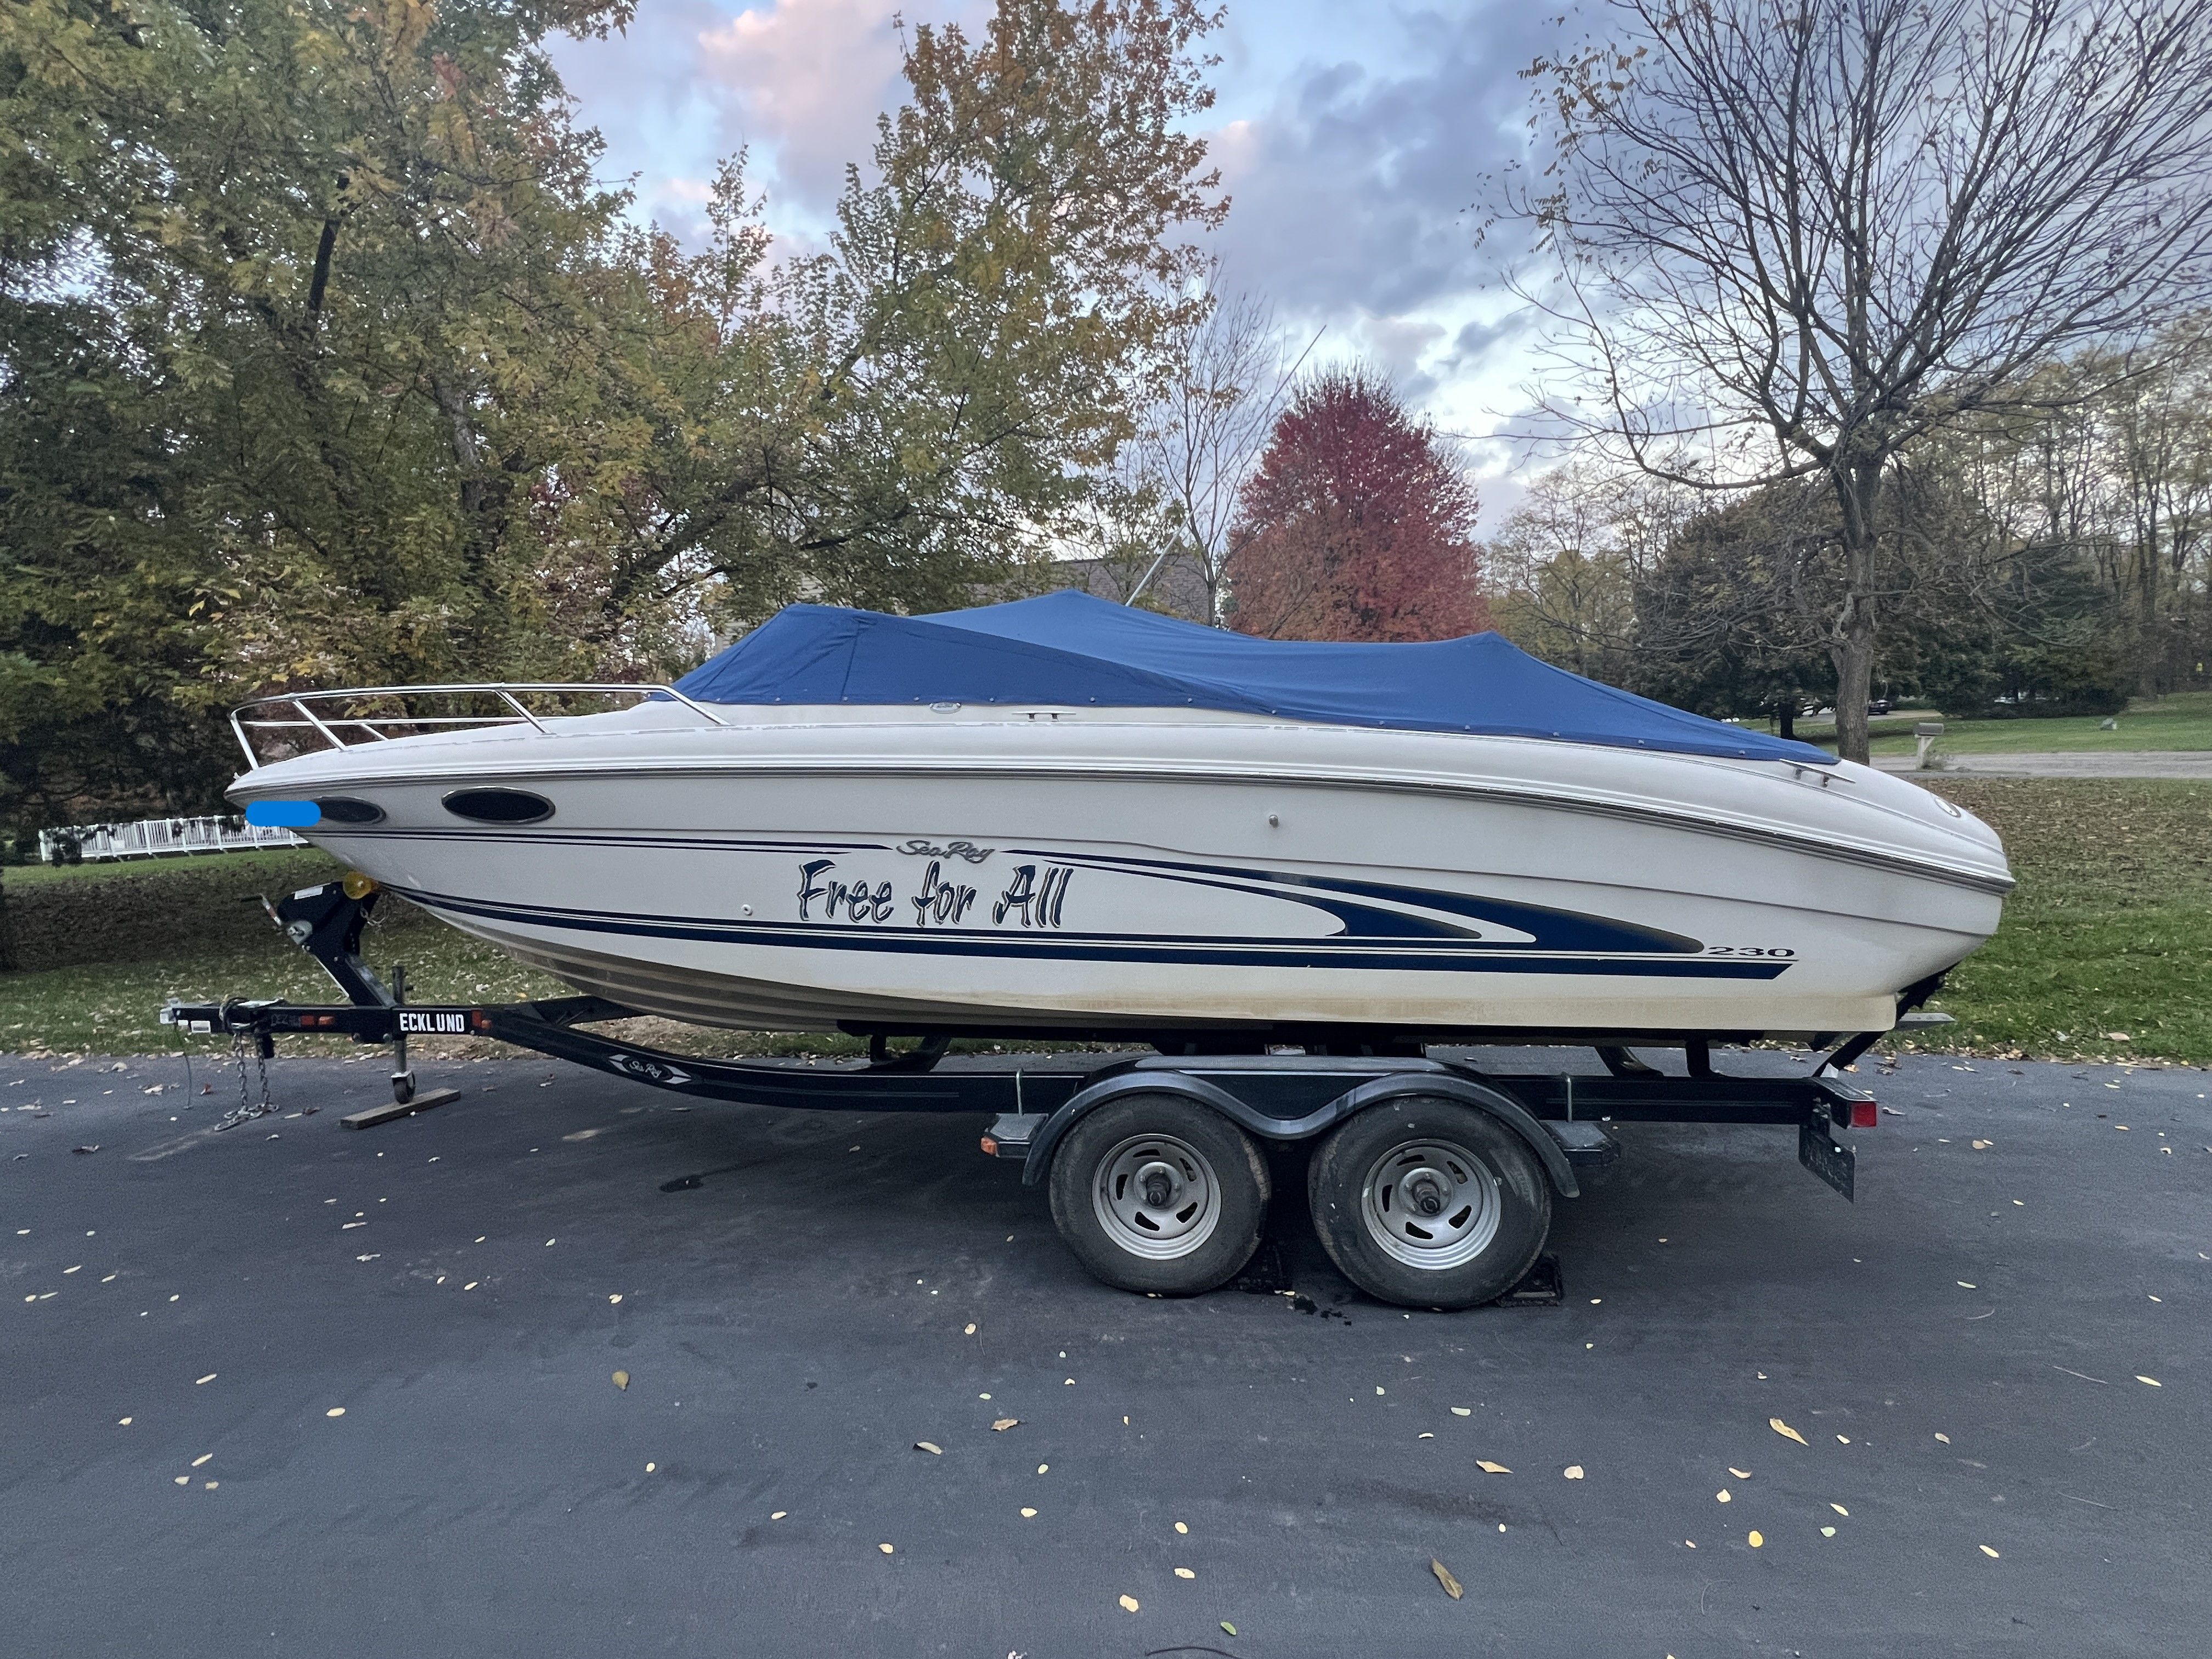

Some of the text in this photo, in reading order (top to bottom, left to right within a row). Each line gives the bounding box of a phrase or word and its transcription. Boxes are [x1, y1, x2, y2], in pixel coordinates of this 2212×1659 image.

[797, 860, 1074, 928] Free for All
[1708, 946, 1795, 957] 230
[399, 1013, 465, 1032] ECKLUND
